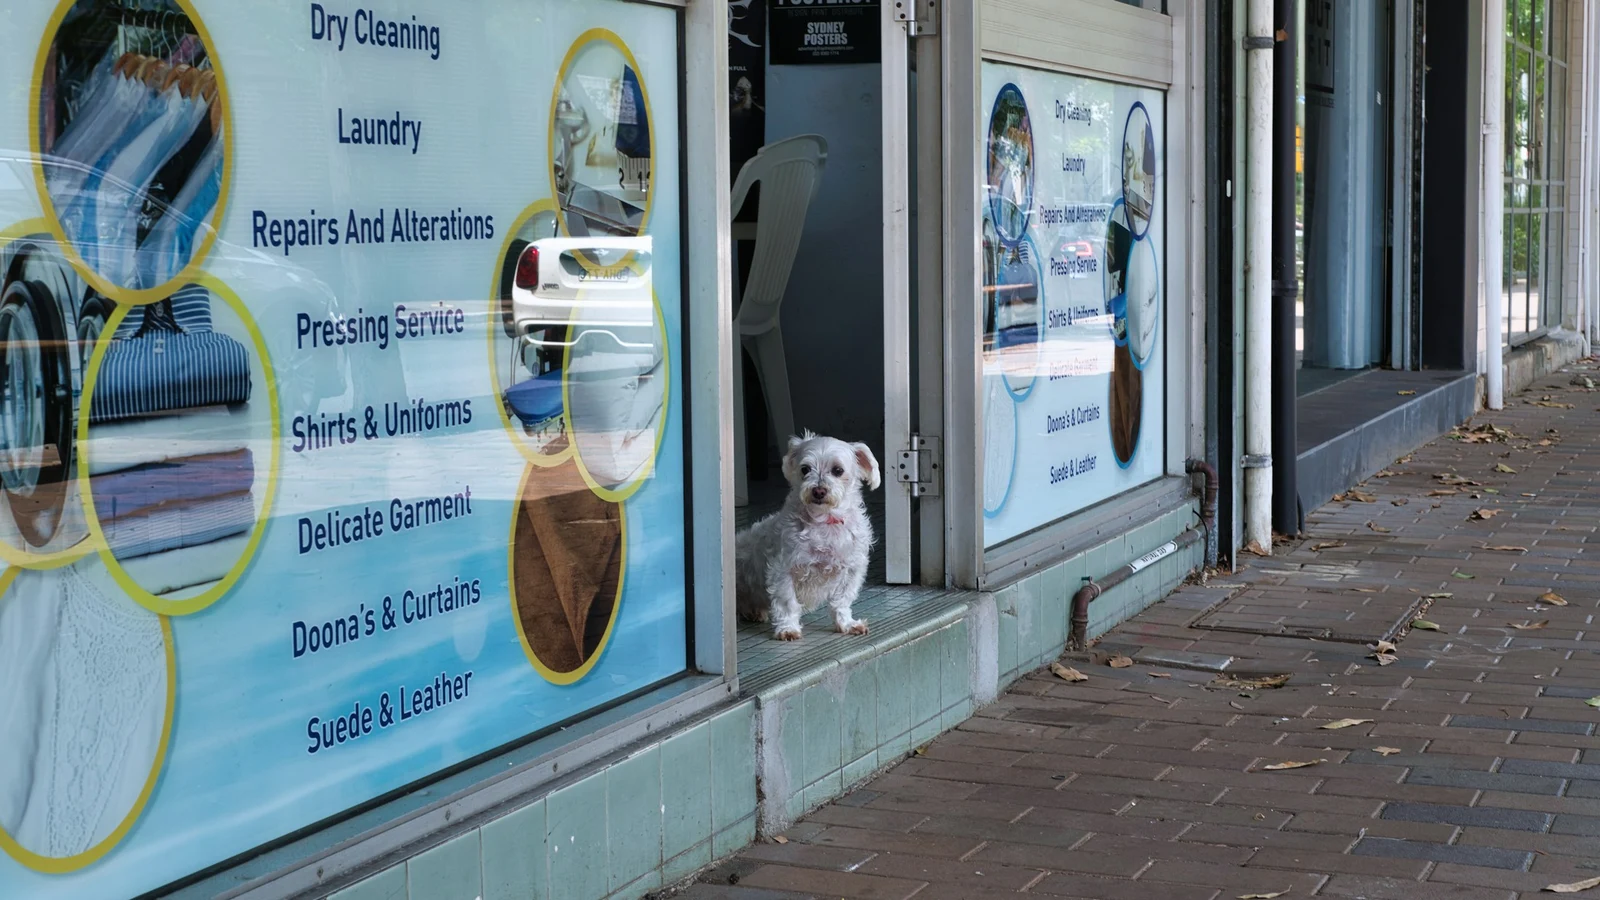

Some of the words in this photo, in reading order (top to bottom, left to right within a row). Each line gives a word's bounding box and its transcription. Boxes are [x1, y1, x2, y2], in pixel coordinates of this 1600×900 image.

[311, 3, 348, 51] Dry
[354, 8, 440, 60] Cleaning
[804, 33, 848, 45] POSTERS
[807, 21, 845, 34] SYDNEY
[1055, 99, 1066, 124] Dry
[1066, 100, 1092, 126] Cleaning
[338, 108, 421, 154] Laundry
[1062, 153, 1085, 175] Laundry
[1039, 206, 1063, 226] Repairs
[1063, 205, 1076, 223] And
[252, 209, 339, 256] Repairs
[345, 208, 384, 244] And
[390, 207, 494, 243] Alterations
[1050, 257, 1076, 279] Pressing
[1076, 255, 1097, 274] Service
[296, 308, 389, 350] Pressing
[395, 301, 465, 339] Service
[1048, 309, 1066, 329] Shirts
[1066, 307, 1073, 326] &
[292, 412, 357, 453] Shirts
[364, 406, 379, 440] &
[385, 398, 472, 436] Uniforms
[1047, 410, 1070, 434] Doona's
[1071, 408, 1076, 427] &
[1076, 403, 1100, 425] Curtains
[1050, 460, 1068, 485] Suede
[1069, 459, 1075, 478] &
[1075, 455, 1097, 475] Leather
[298, 506, 383, 554] Delicate
[389, 485, 472, 532] Garment
[292, 603, 375, 658] Doona's
[382, 596, 396, 631] &
[402, 576, 480, 624] Curtains
[307, 702, 373, 754] Suede
[379, 692, 394, 727] &
[400, 671, 473, 720] Leather
